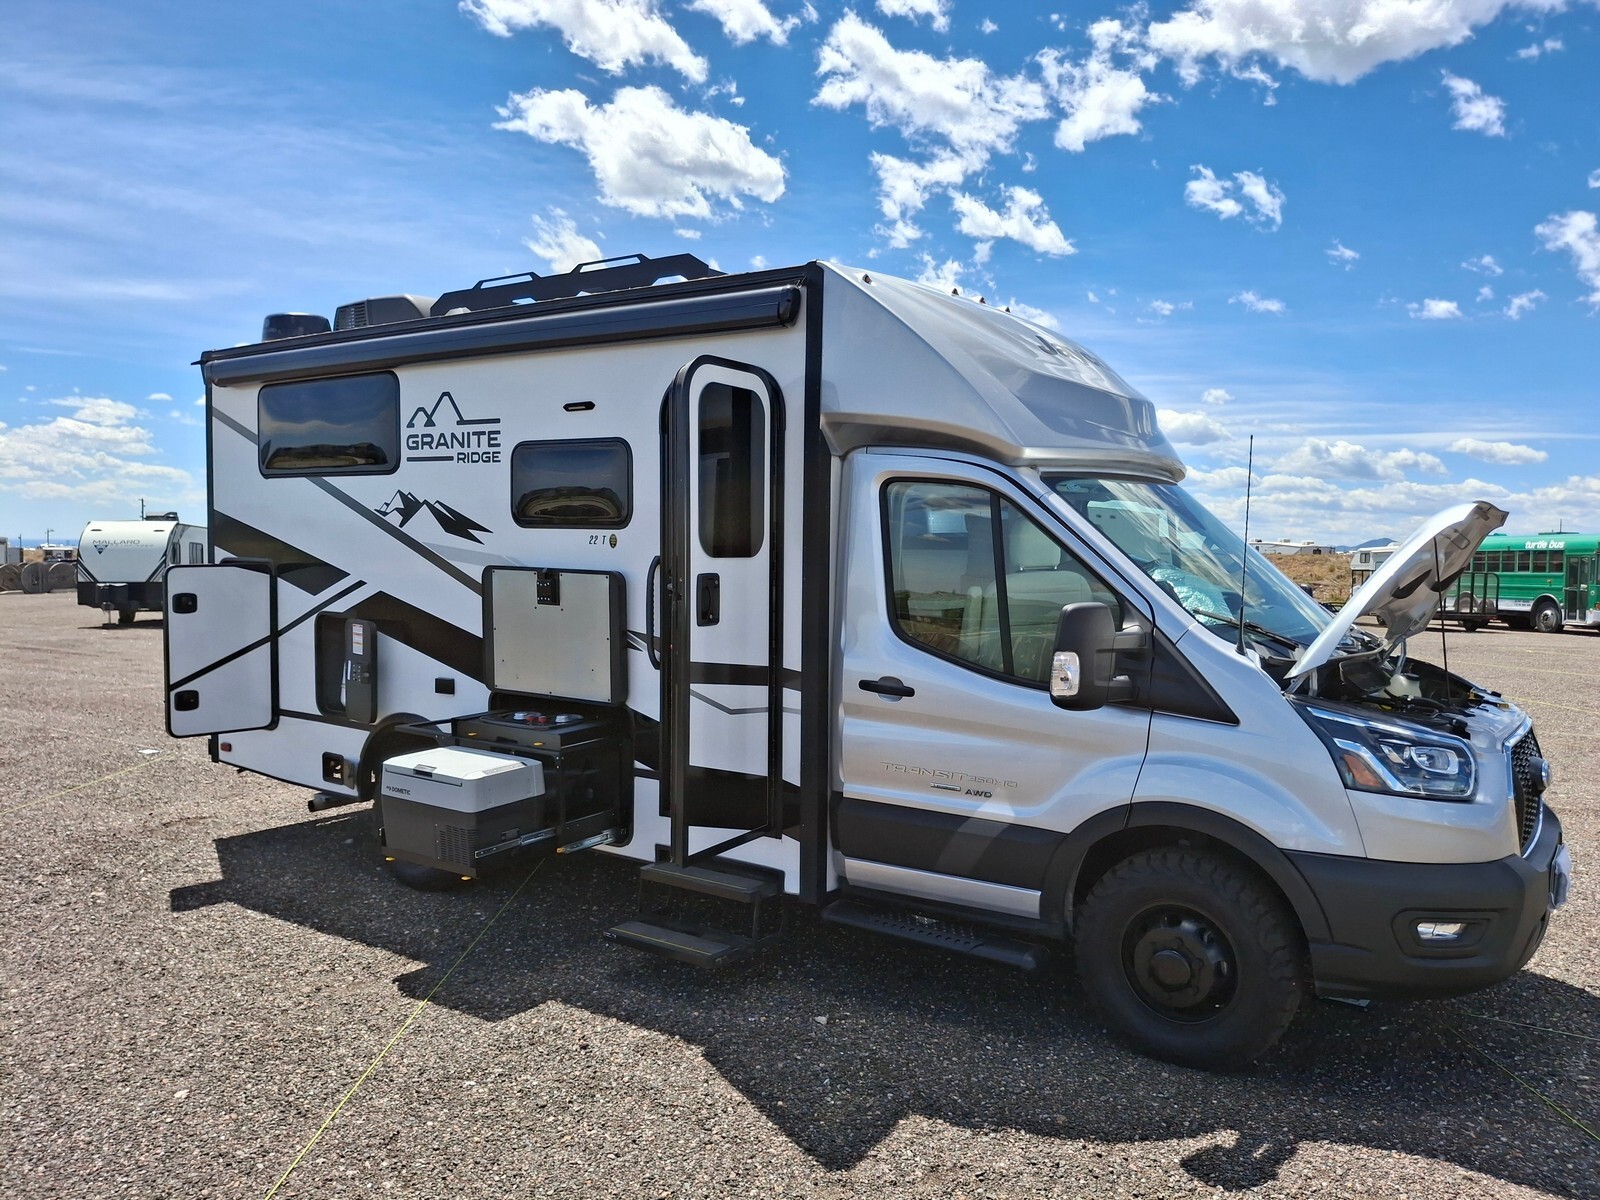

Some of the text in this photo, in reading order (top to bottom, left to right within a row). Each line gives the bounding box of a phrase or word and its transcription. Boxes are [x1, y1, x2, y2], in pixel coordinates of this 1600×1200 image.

[406, 430, 501, 450] GRANITE
[457, 451, 501, 463] RIDGE
[588, 535, 599, 545] 22
[1525, 540, 1565, 549] turtle bus
[880, 761, 968, 781] TRANSIT
[391, 786, 411, 796] DOMETIC
[964, 788, 993, 798] AWD
